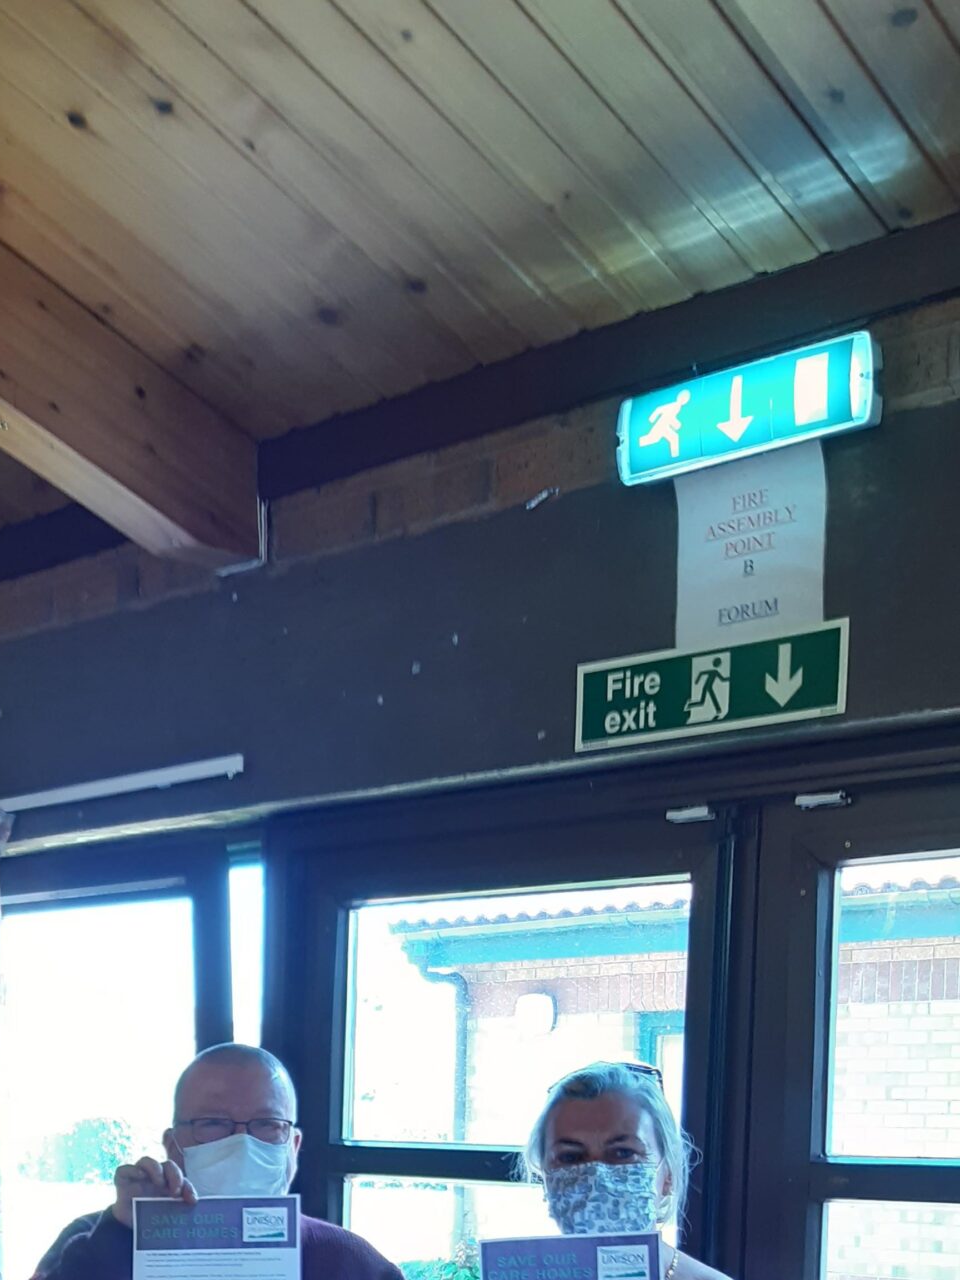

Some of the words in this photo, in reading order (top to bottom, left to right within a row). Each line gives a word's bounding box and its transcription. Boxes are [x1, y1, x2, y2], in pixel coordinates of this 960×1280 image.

[731, 489, 768, 514] FIRE
[705, 504, 797, 542] ASSEMBLY
[724, 532, 776, 559] POINT
[743, 559, 755, 576] B
[718, 597, 780, 625] FORUM
[607, 670, 661, 701] Fire
[604, 700, 657, 734] exit
[151, 1215, 188, 1225] SAVE
[193, 1213, 225, 1225] OUR
[246, 1215, 285, 1226] UNISON
[142, 1228, 180, 1240] CARE
[187, 1227, 238, 1239] HOMES
[497, 1254, 536, 1267] SAVE
[543, 1252, 576, 1265] OUR
[601, 1254, 645, 1265] UNISON
[536, 1267, 592, 1280] HOMES
